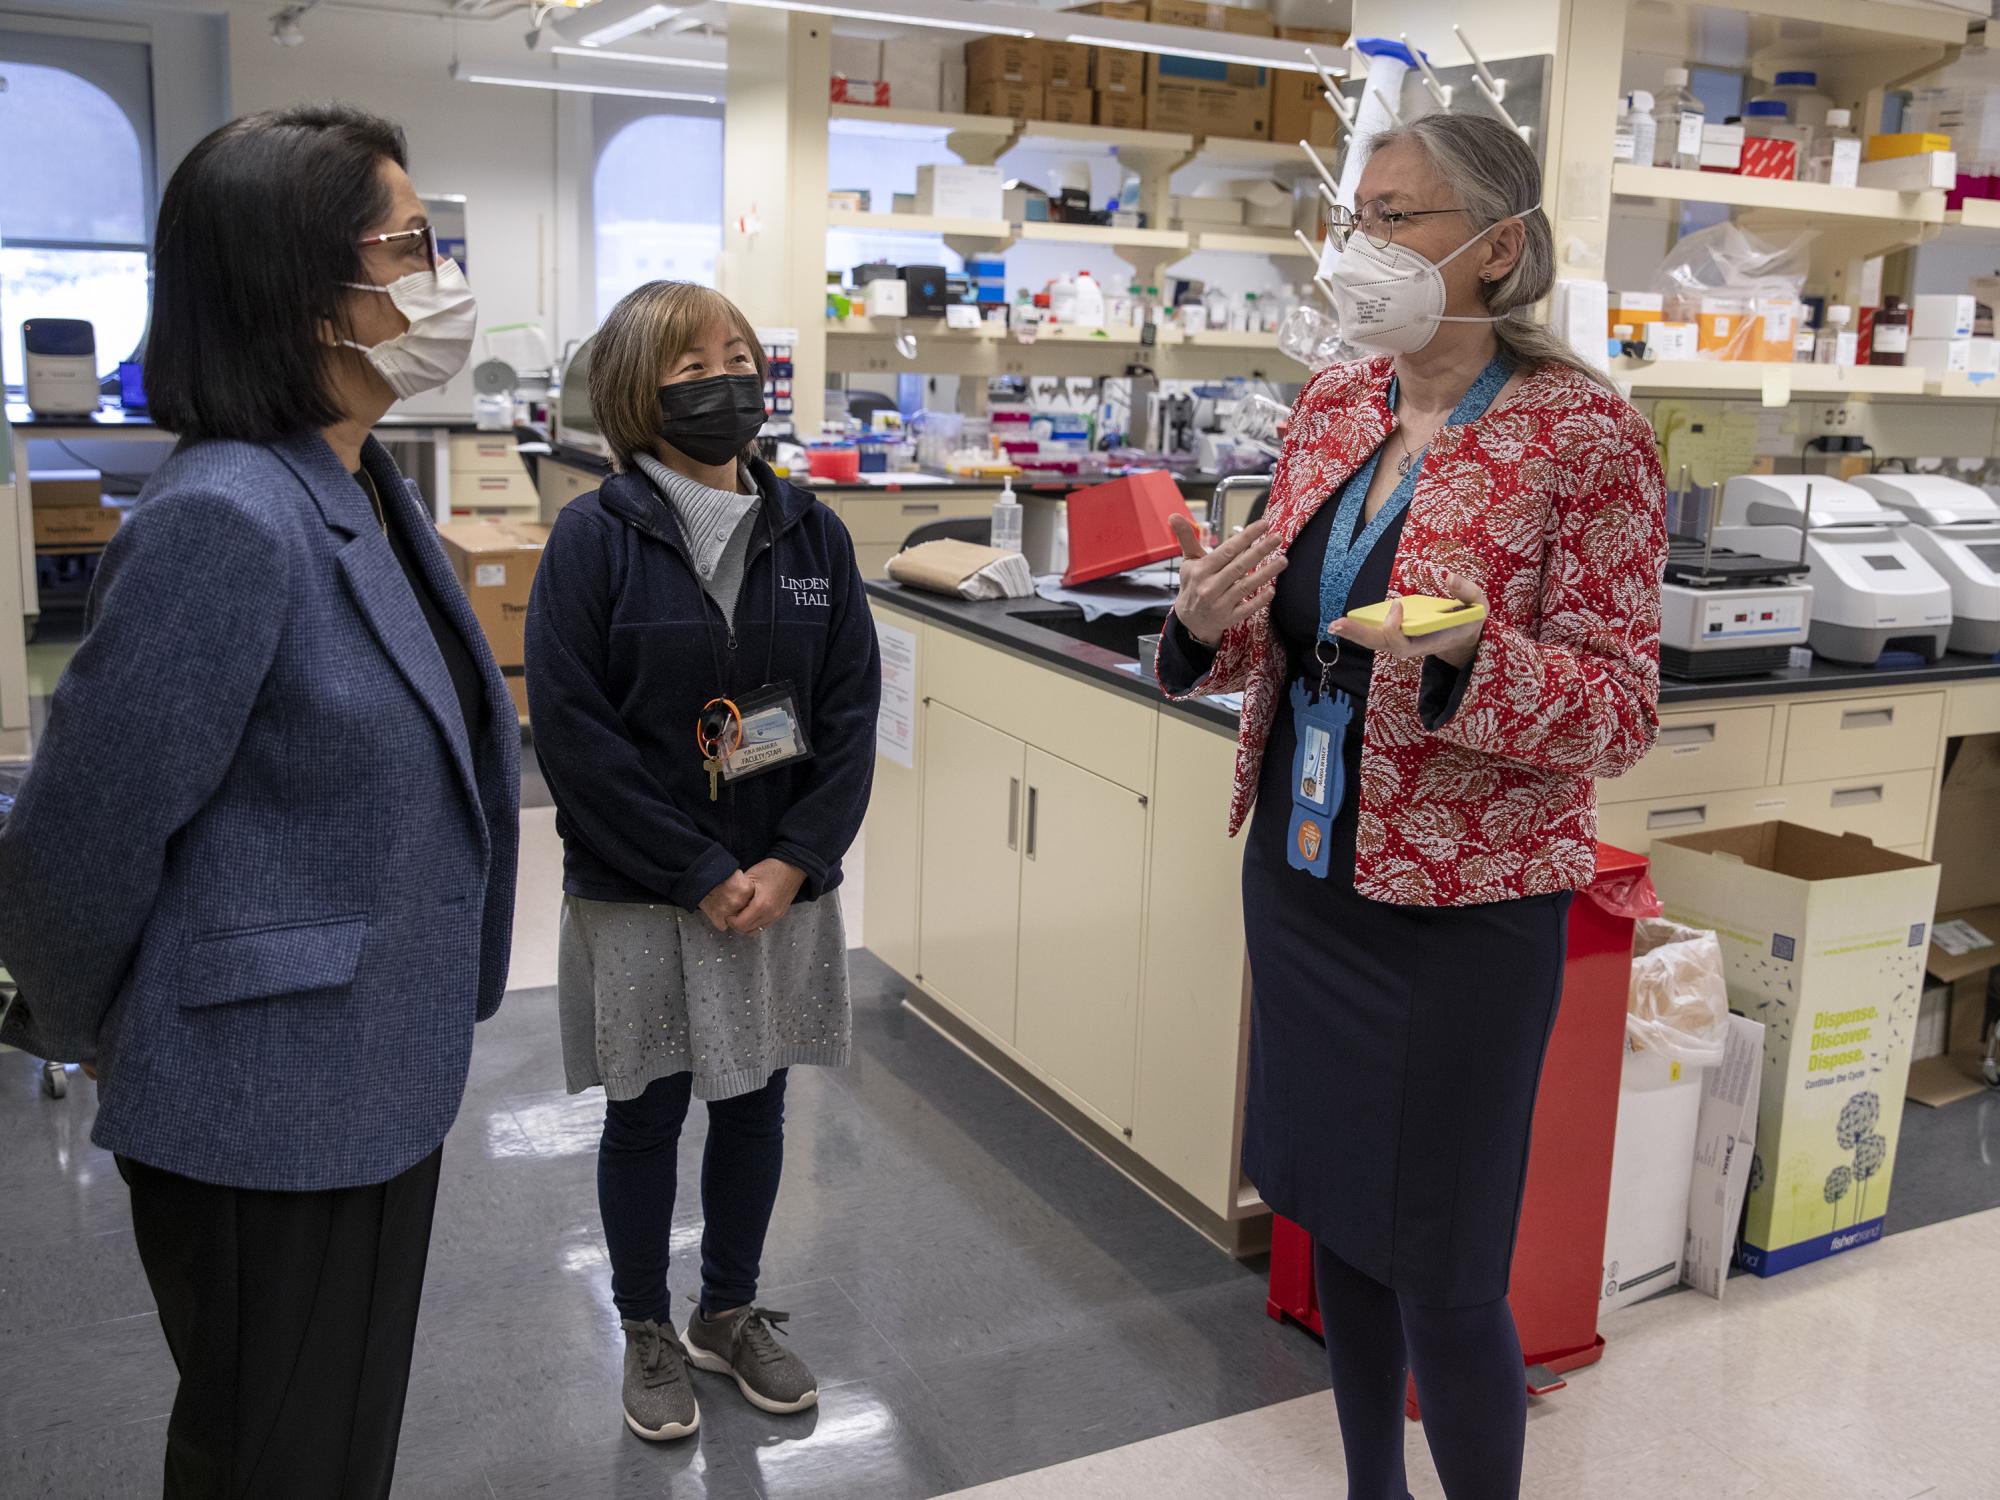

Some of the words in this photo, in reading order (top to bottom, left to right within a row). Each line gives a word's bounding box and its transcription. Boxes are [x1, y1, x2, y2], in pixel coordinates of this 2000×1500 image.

[779, 575, 829, 590] LINDEN
[793, 591, 830, 606] HALL
[741, 747, 783, 765] FACULTY/STAFF
[1813, 1006, 1878, 1030] Dispense.
[1810, 1027, 1872, 1051] Discover.
[1808, 1048, 1865, 1072] Dispose.
[1804, 1077, 1835, 1090] Continue
[1836, 1074, 1847, 1083] the
[1848, 1070, 1865, 1081] Cycle
[1830, 1223, 1881, 1250] fisherbrand
